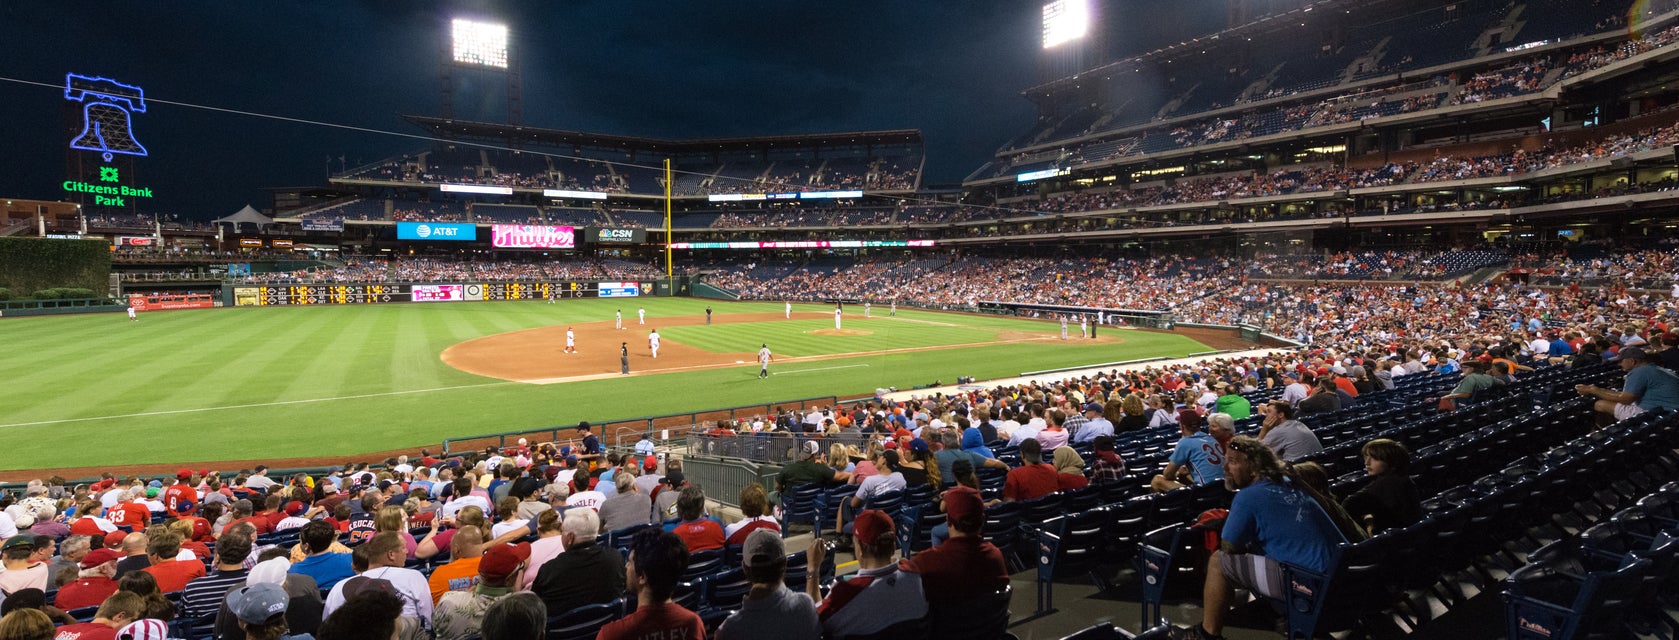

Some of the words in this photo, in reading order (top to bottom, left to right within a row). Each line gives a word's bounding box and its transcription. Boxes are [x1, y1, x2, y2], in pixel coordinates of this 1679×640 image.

[63, 181, 119, 195] Citizens
[120, 185, 153, 198] Bank
[95, 195, 125, 207] Park
[433, 227, 458, 236] AT&T
[492, 225, 574, 248] Phillies
[612, 229, 633, 238] CSN
[108, 509, 126, 523] 33
[348, 519, 377, 531] KEUCH
